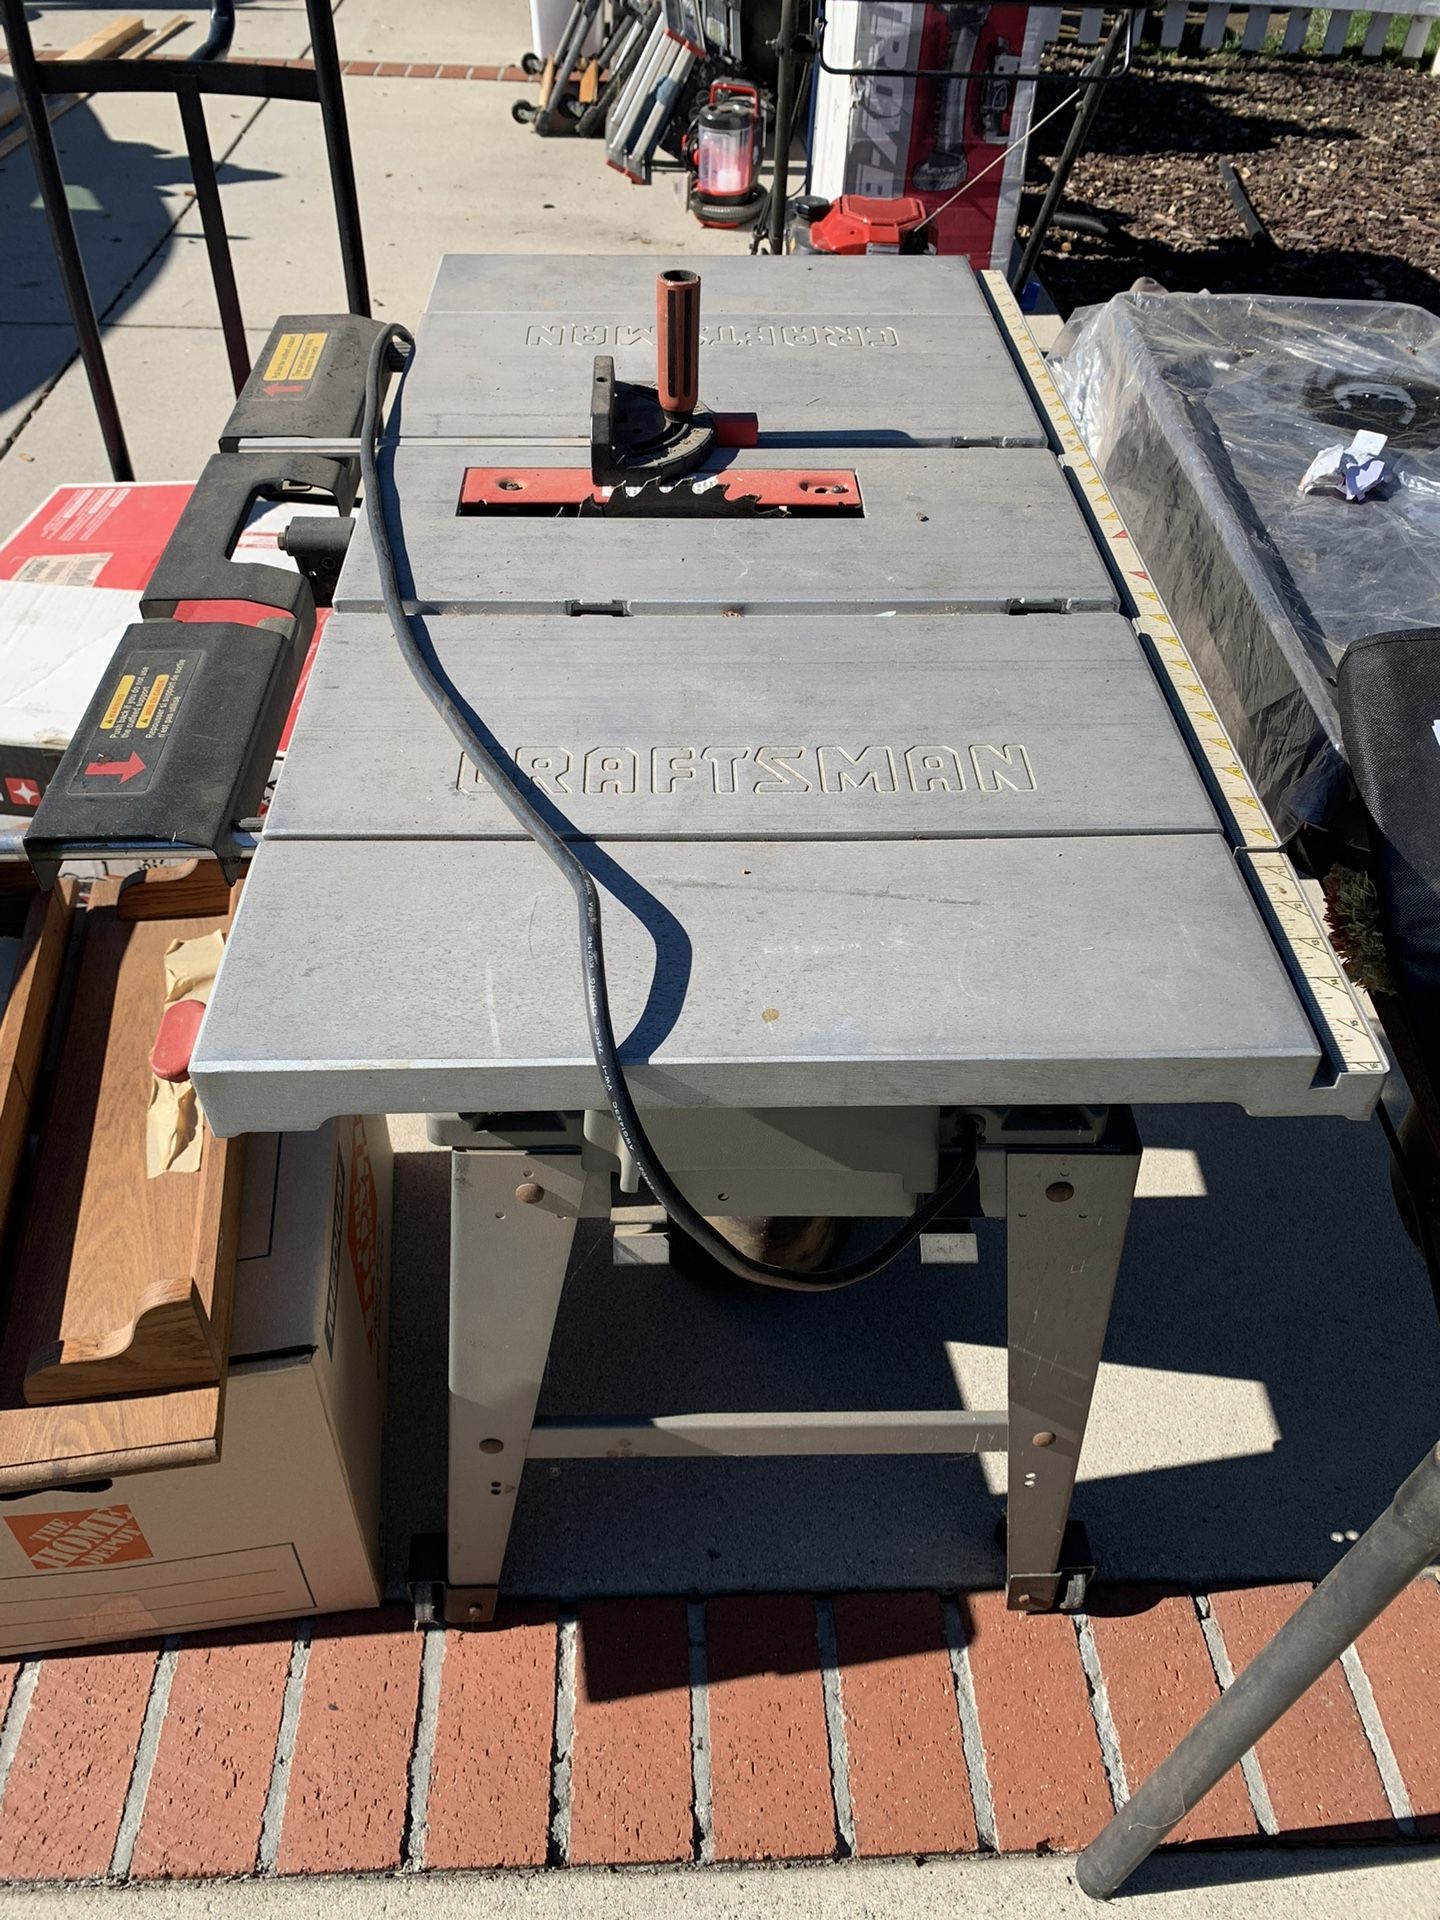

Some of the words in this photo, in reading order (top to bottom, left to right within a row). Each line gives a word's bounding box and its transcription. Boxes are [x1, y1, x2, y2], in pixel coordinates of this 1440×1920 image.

[525, 324, 900, 346] CRAFTMAN
[135, 676, 145, 686] not
[140, 666, 149, 676] use
[128, 694, 137, 705] you
[131, 686, 140, 694] do
[117, 710, 130, 723] back
[120, 729, 131, 738] the
[136, 686, 150, 707] support
[145, 709, 165, 738] Repousser
[163, 681, 177, 703] support
[109, 724, 124, 738] Push
[1261, 829, 1271, 837] 10
[589, 977, 598, 1017] CHUNG
[602, 1064, 613, 1092] VW-1
[612, 1101, 634, 1151] AWG14X3C
[28, 1518, 73, 1542] THE
[30, 1507, 133, 1568] HOME
[79, 1525, 142, 1564] DEPOT
